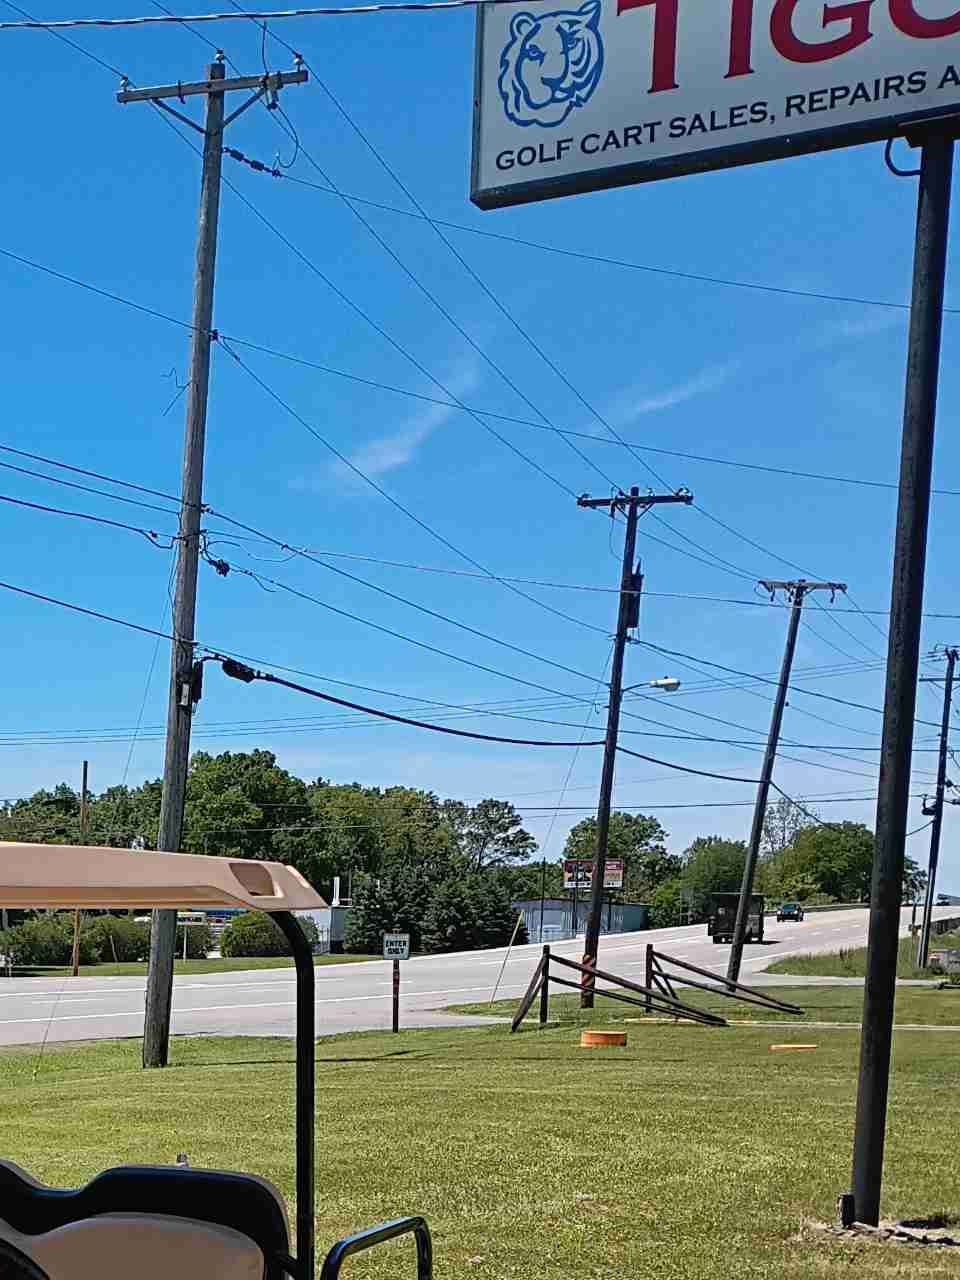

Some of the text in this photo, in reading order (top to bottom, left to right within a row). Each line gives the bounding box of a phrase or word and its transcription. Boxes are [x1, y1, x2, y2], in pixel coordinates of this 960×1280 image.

[496, 138, 574, 170] GOLF
[580, 121, 662, 154] CART
[669, 102, 776, 138] SALES,
[785, 70, 927, 117] REPAIRS
[385, 940, 407, 948] ENTER
